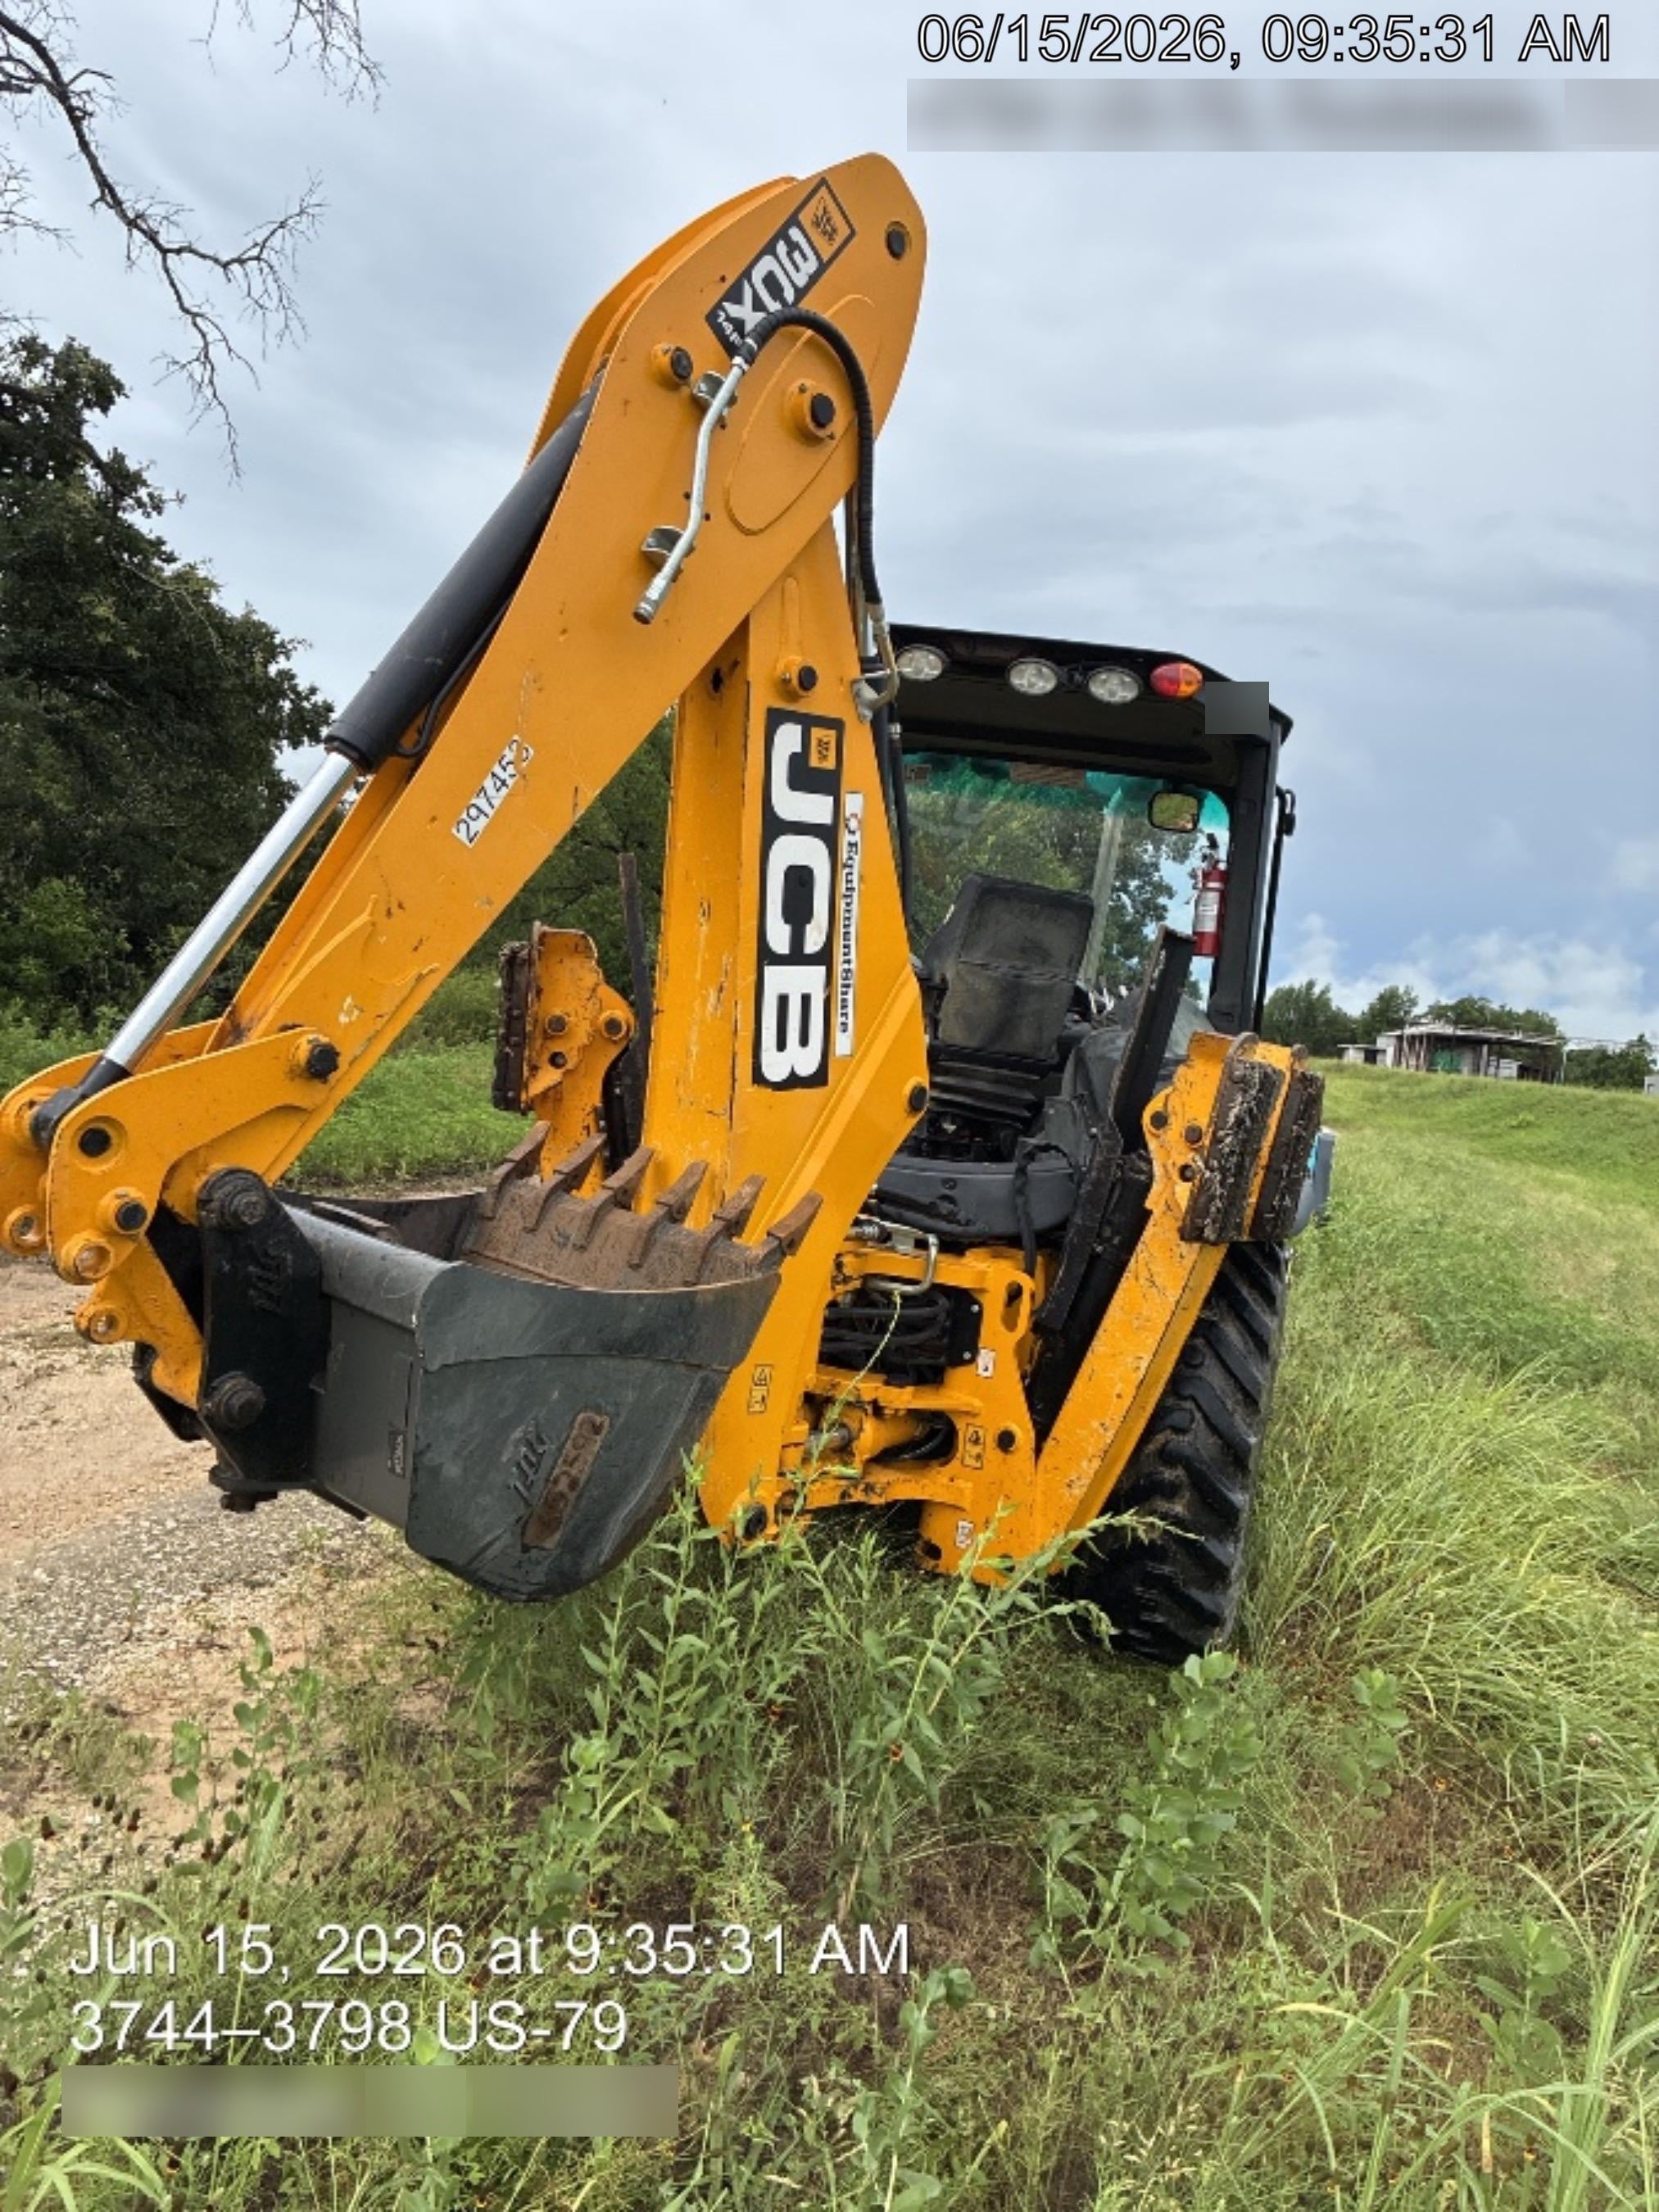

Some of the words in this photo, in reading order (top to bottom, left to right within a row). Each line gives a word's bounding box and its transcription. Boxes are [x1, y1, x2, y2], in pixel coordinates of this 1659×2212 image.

[722, 225, 819, 335] 3CX
[760, 722, 834, 1082] JCB
[839, 840, 859, 1033] EquipmentShare
